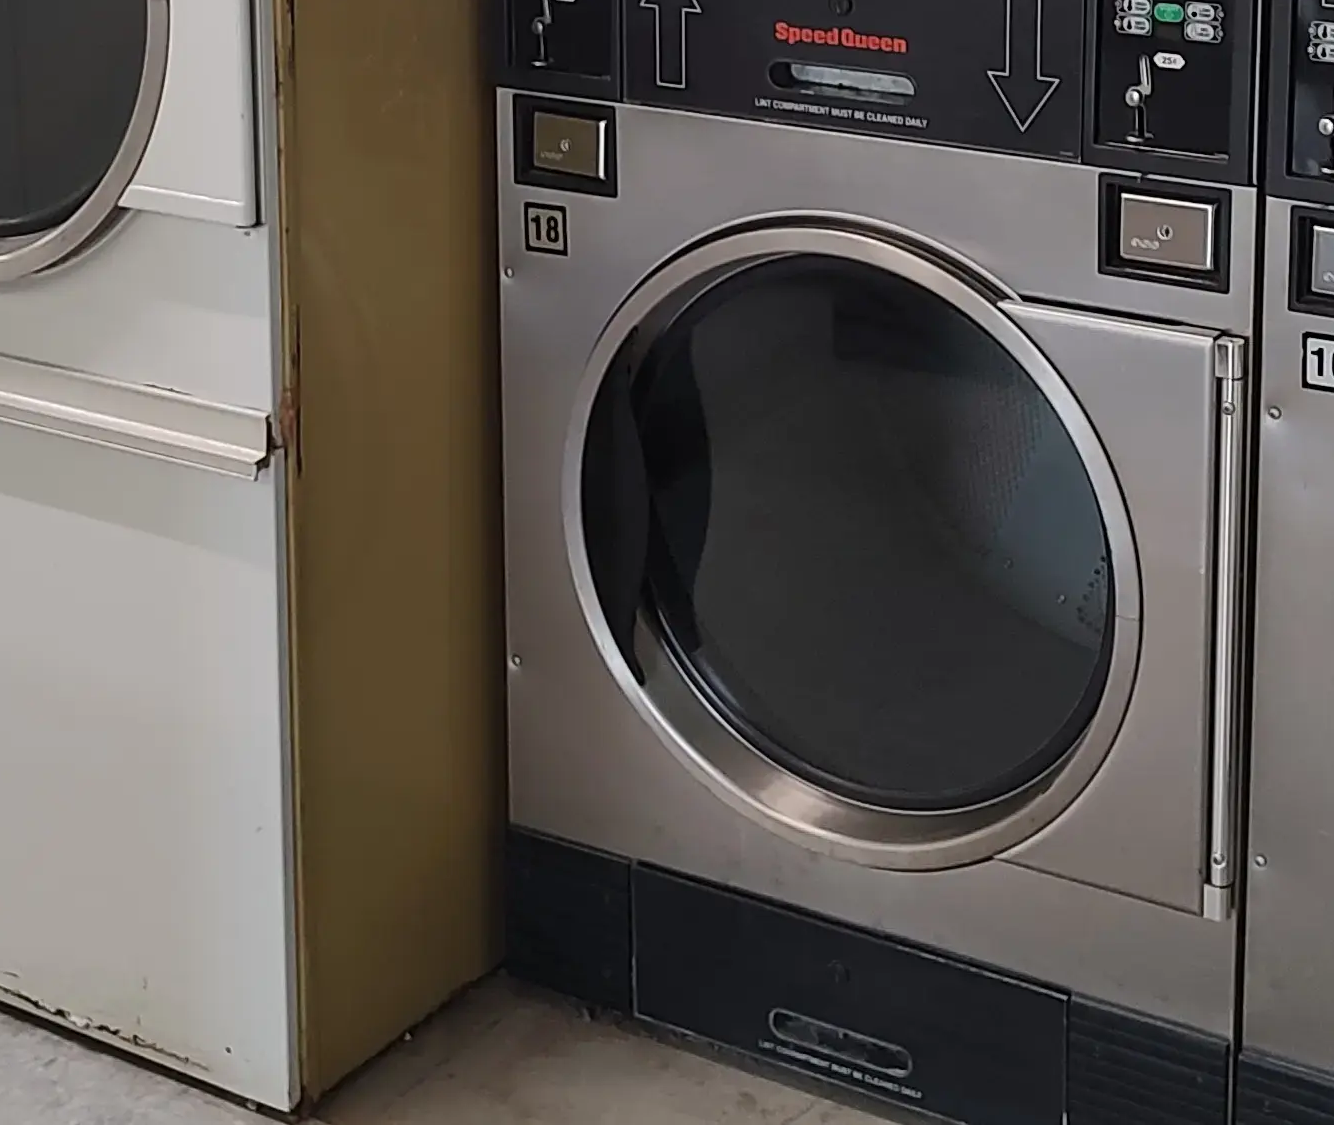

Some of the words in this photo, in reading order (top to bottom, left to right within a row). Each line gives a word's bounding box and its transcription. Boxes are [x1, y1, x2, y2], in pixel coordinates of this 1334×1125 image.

[775, 21, 839, 46] Speed
[841, 28, 908, 53] Queen
[755, 97, 771, 108] LINT
[772, 99, 831, 116] COMPARTMENT
[831, 107, 852, 119] MUST
[854, 109, 865, 120] BE
[866, 111, 904, 126] CLEANED
[905, 116, 929, 129] DAILY
[530, 215, 560, 243] 18
